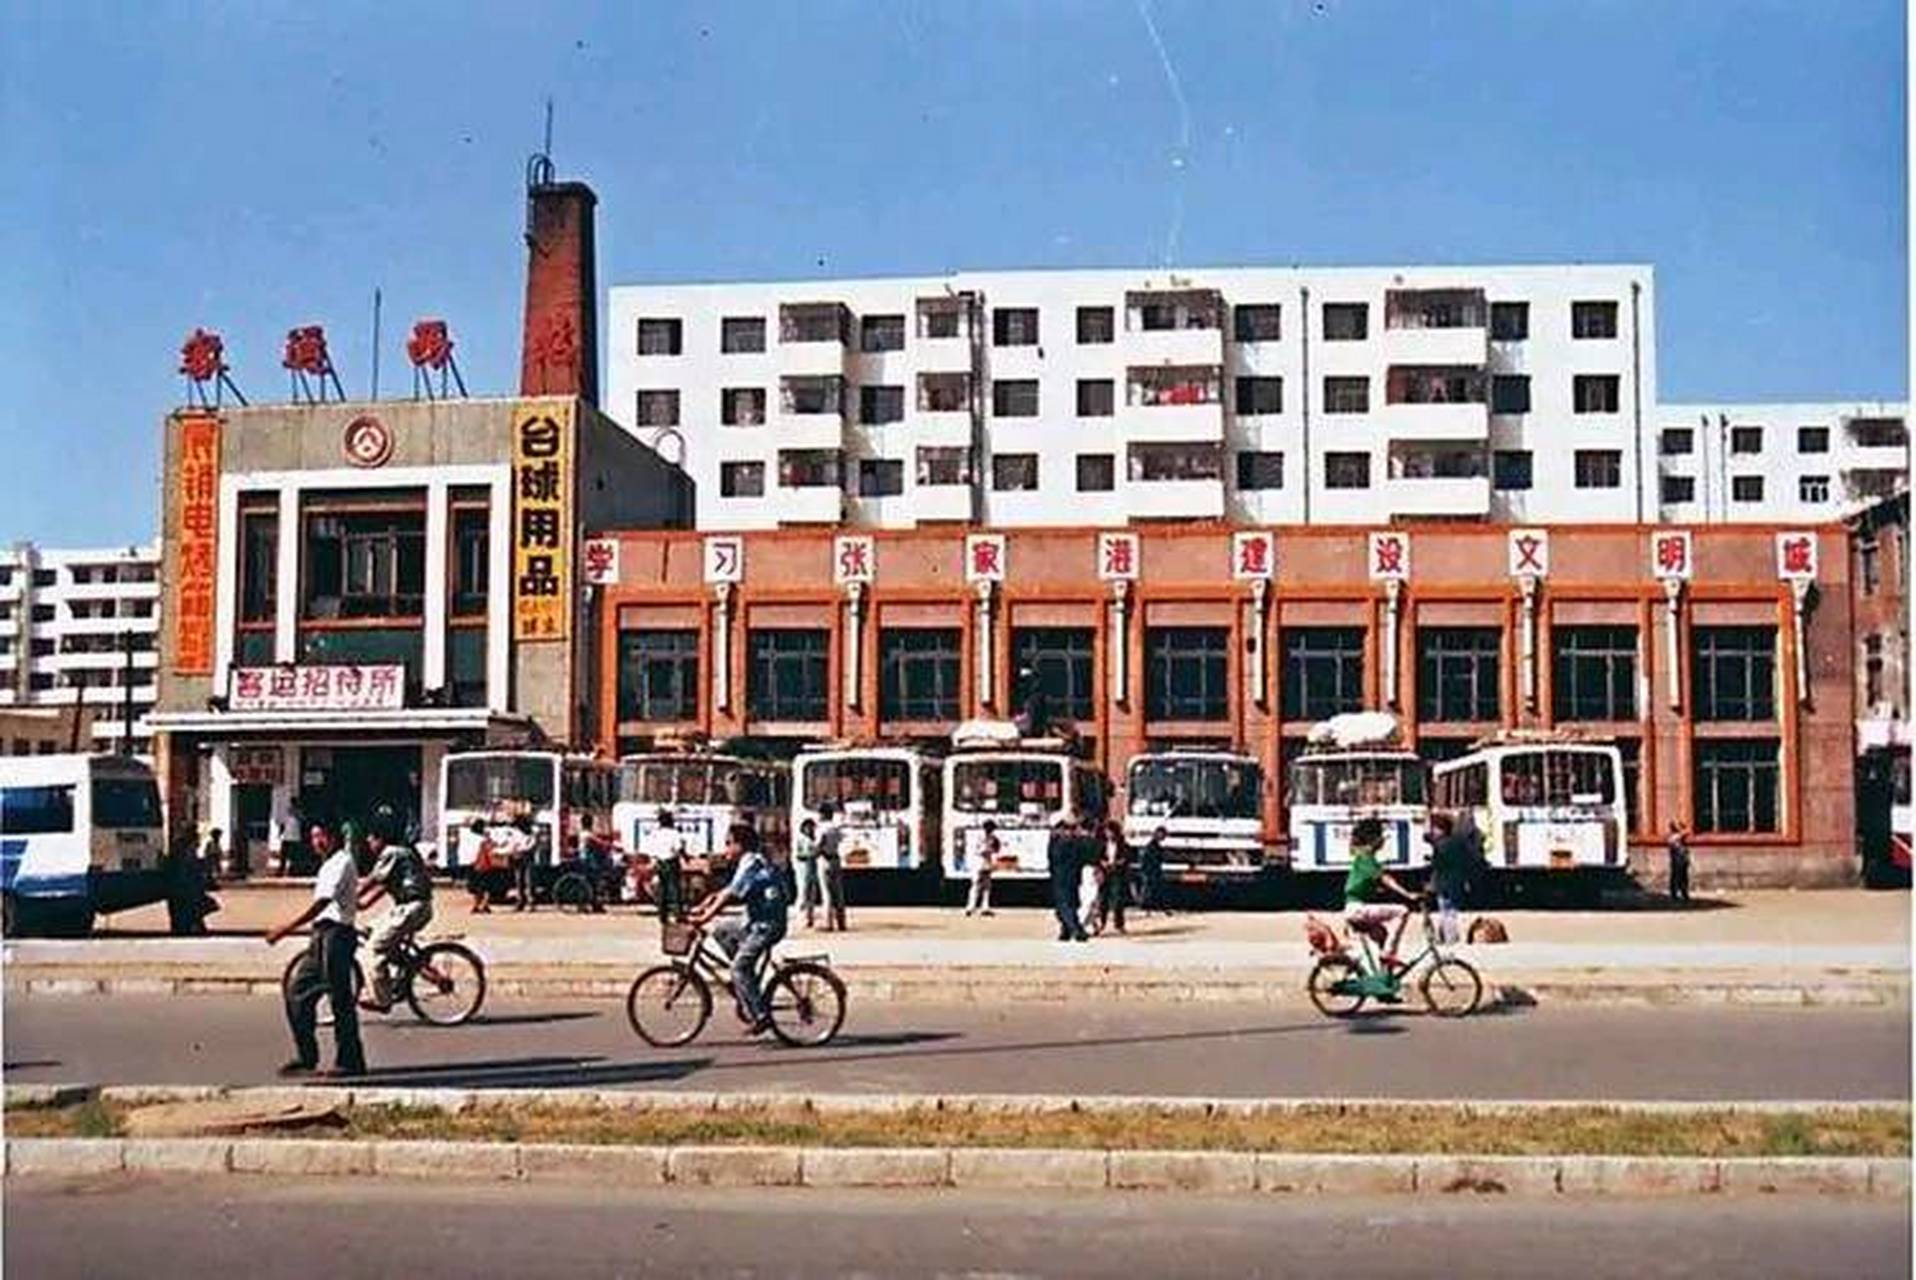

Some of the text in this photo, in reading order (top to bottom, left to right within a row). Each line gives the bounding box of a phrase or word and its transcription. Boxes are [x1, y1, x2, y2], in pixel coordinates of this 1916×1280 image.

[519, 415, 560, 596] 台球用品
[586, 536, 1812, 578] 学习张家港建设文明城
